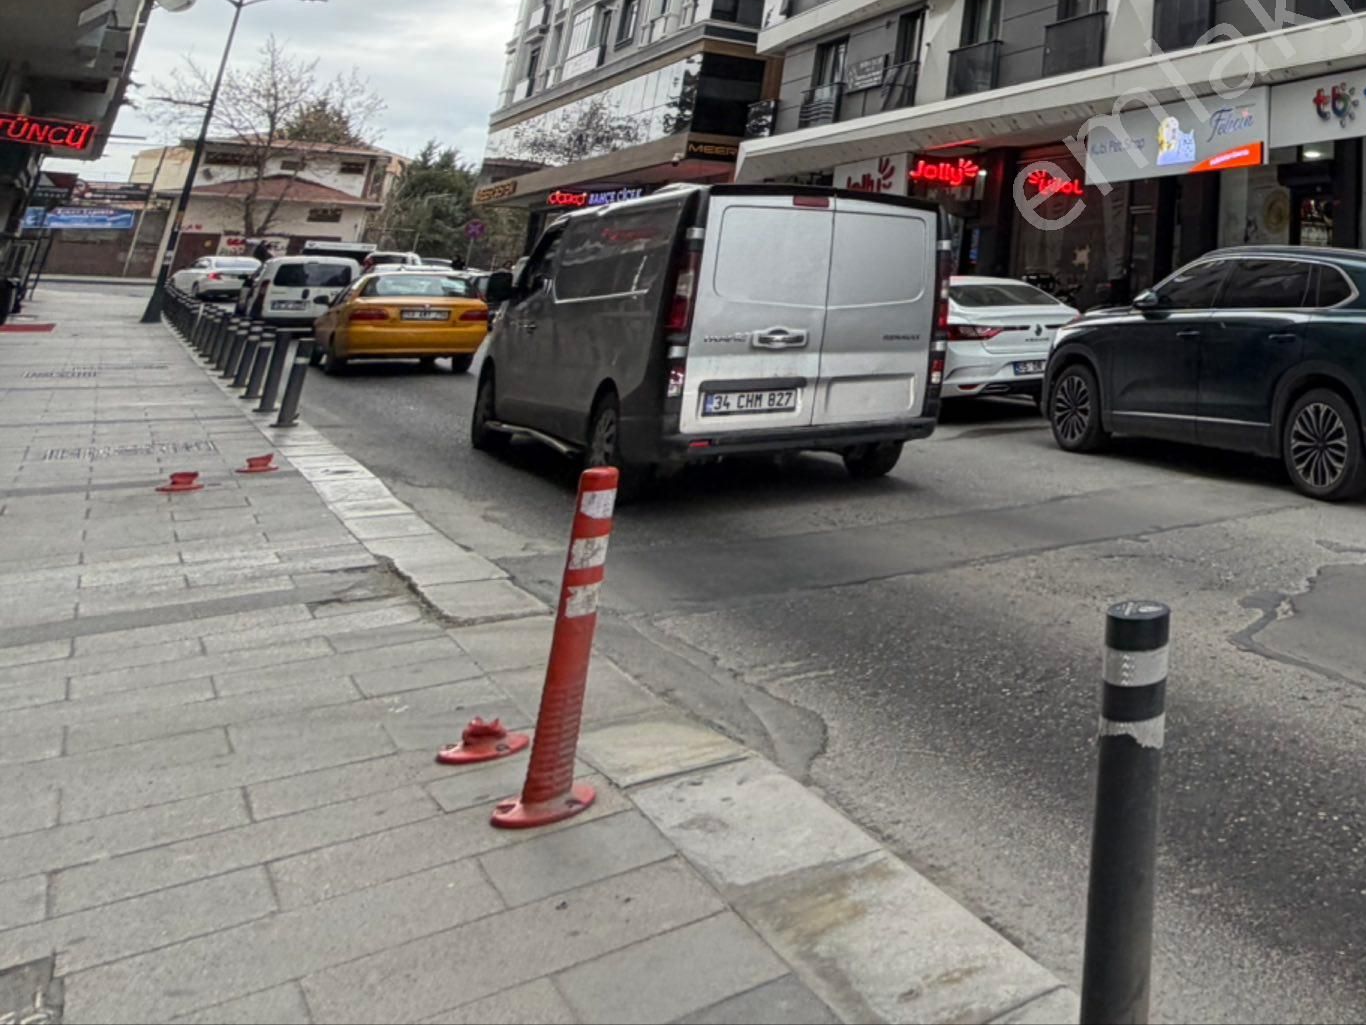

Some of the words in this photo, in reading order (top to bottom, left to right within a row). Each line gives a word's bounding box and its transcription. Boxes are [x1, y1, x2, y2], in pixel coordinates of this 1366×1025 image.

[911, 160, 966, 186] Jolly
[712, 394, 730, 410] 34
[737, 392, 762, 409] CHM
[768, 391, 794, 407] 827
